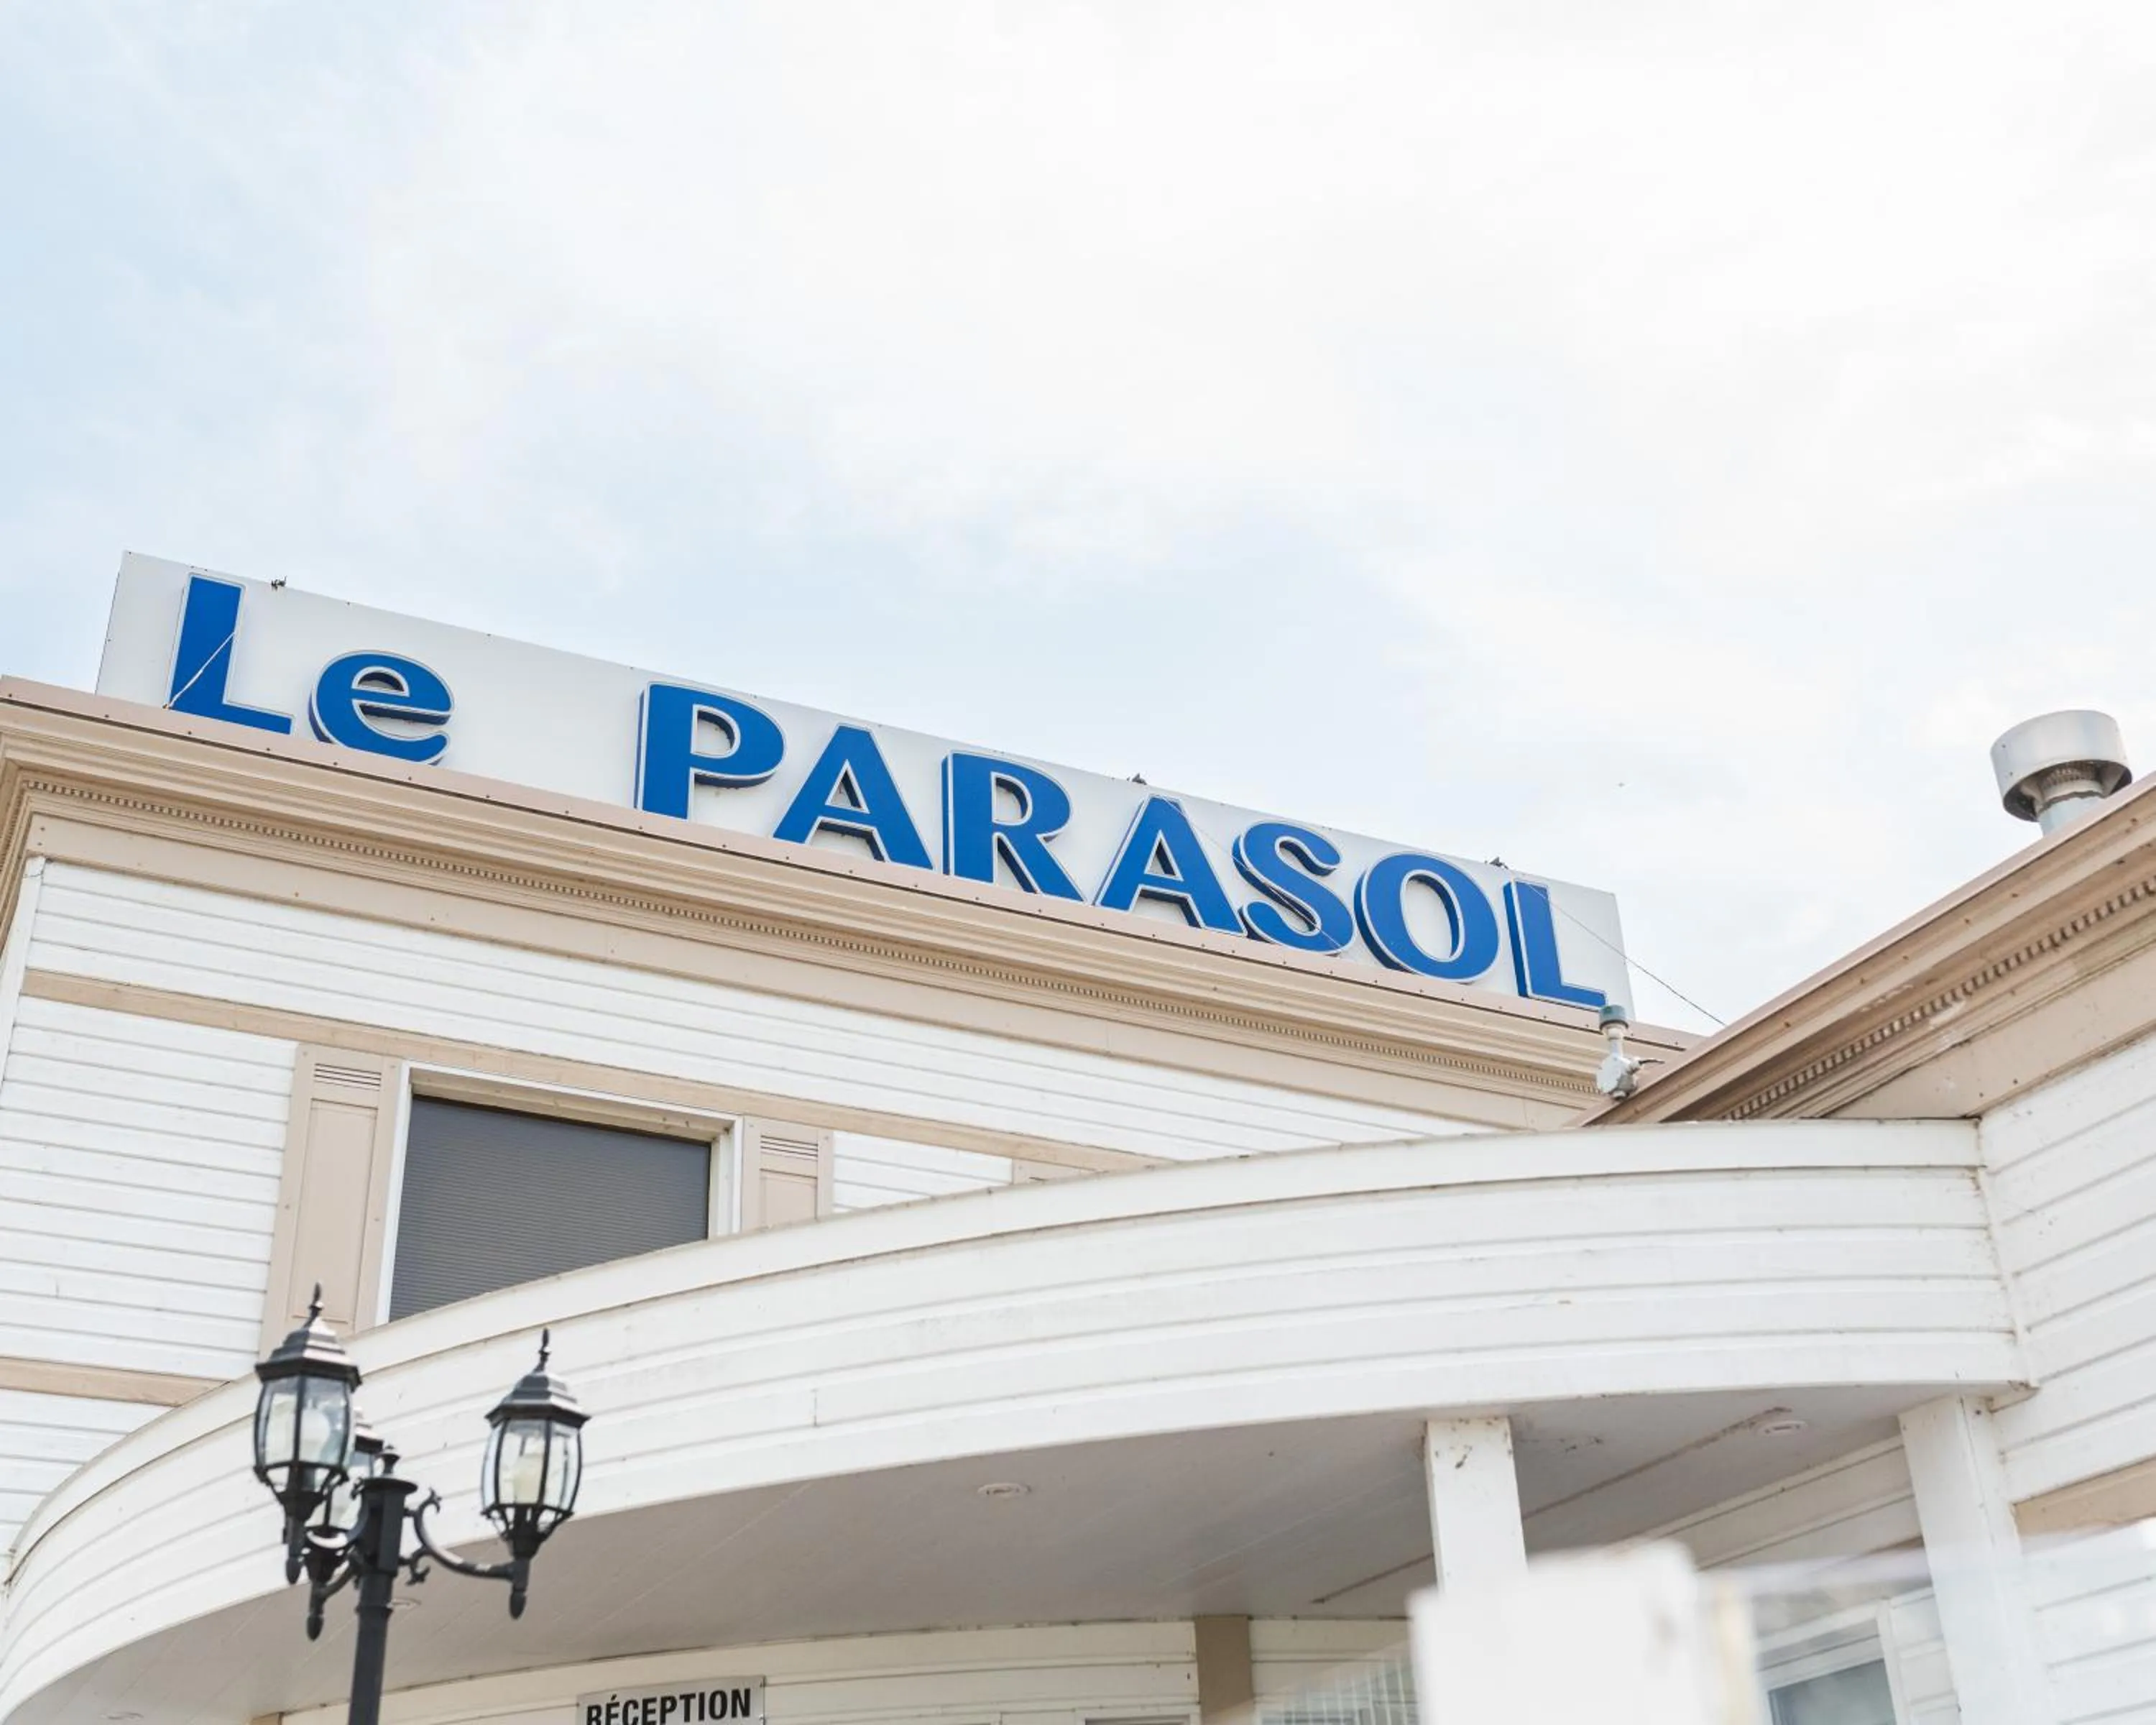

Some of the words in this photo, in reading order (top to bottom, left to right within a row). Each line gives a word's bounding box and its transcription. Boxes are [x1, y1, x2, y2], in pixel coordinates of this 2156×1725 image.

[168, 574, 453, 764] Le
[635, 682, 1608, 1011] PARASOL
[586, 1688, 751, 1725] RÉCEPTION
